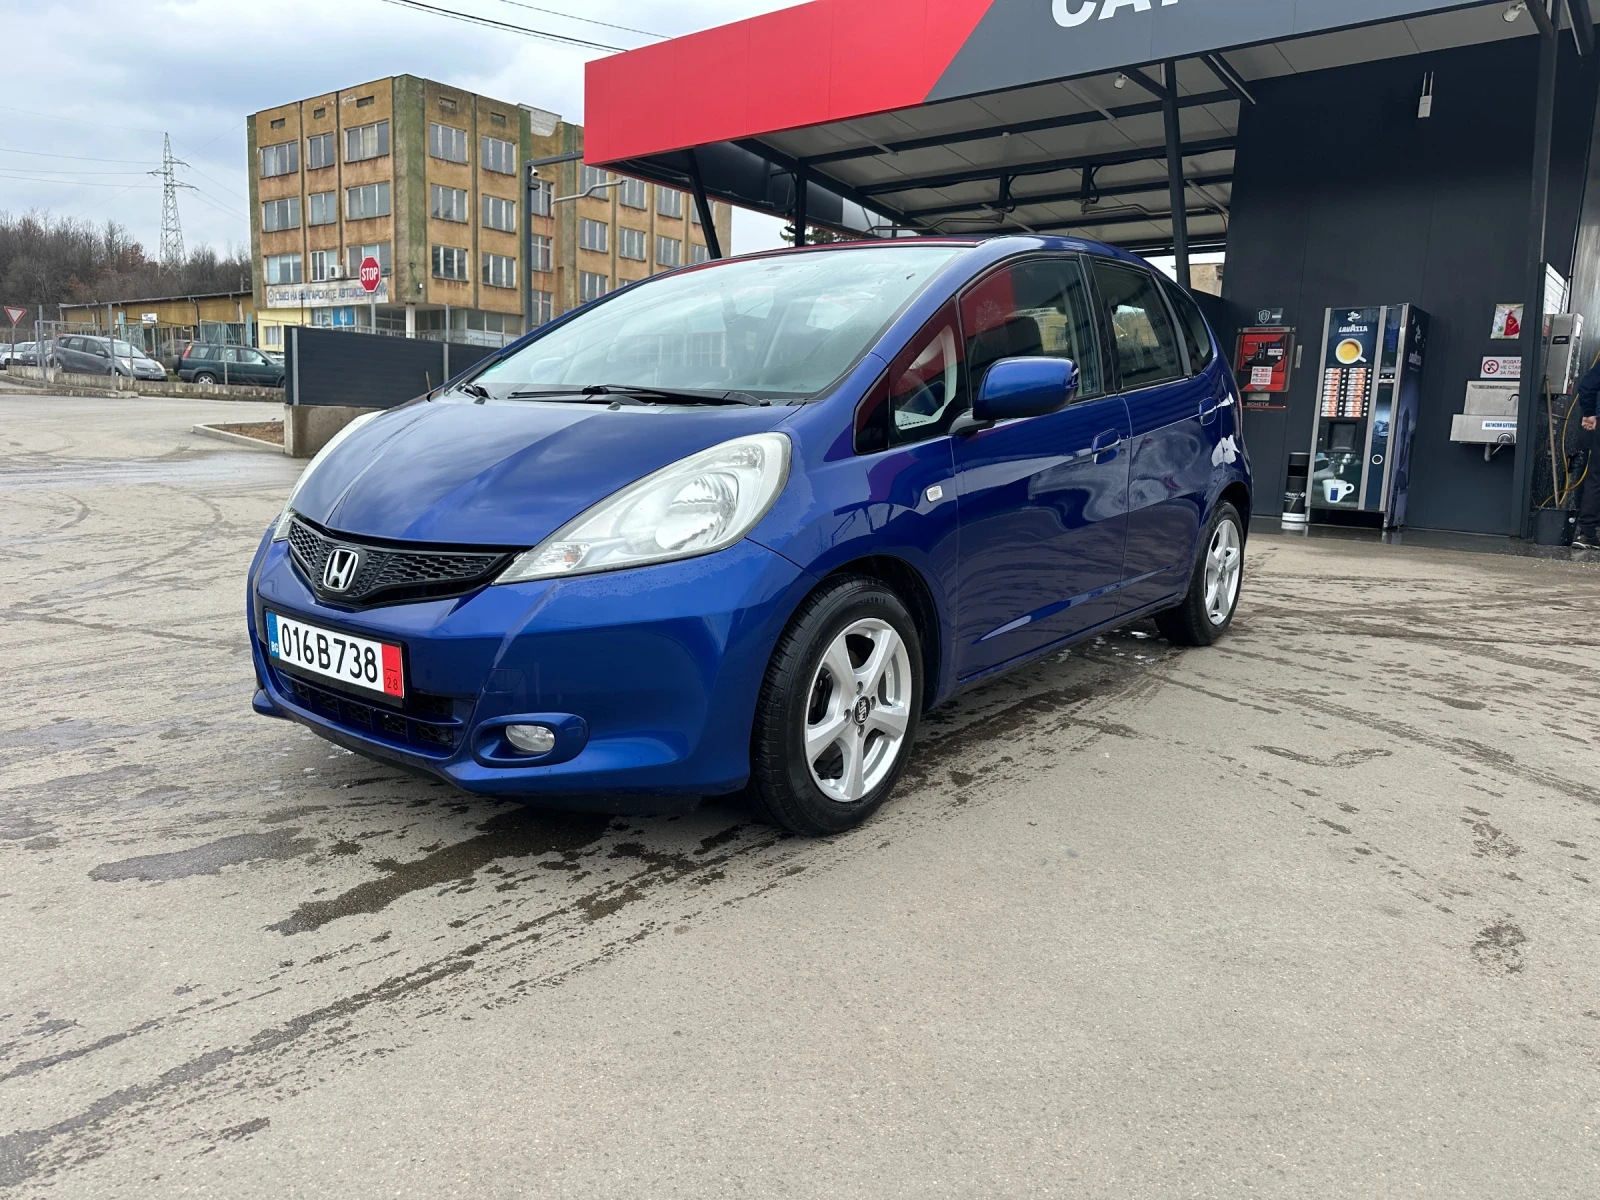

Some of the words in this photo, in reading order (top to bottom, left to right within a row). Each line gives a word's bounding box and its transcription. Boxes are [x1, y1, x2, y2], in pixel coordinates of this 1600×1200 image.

[361, 267, 378, 281] STOP
[291, 290, 298, 300] НА
[1338, 324, 1368, 333] LAVAZZA
[271, 641, 279, 653] BG
[282, 623, 378, 683] 016B738
[387, 677, 398, 691] 28
